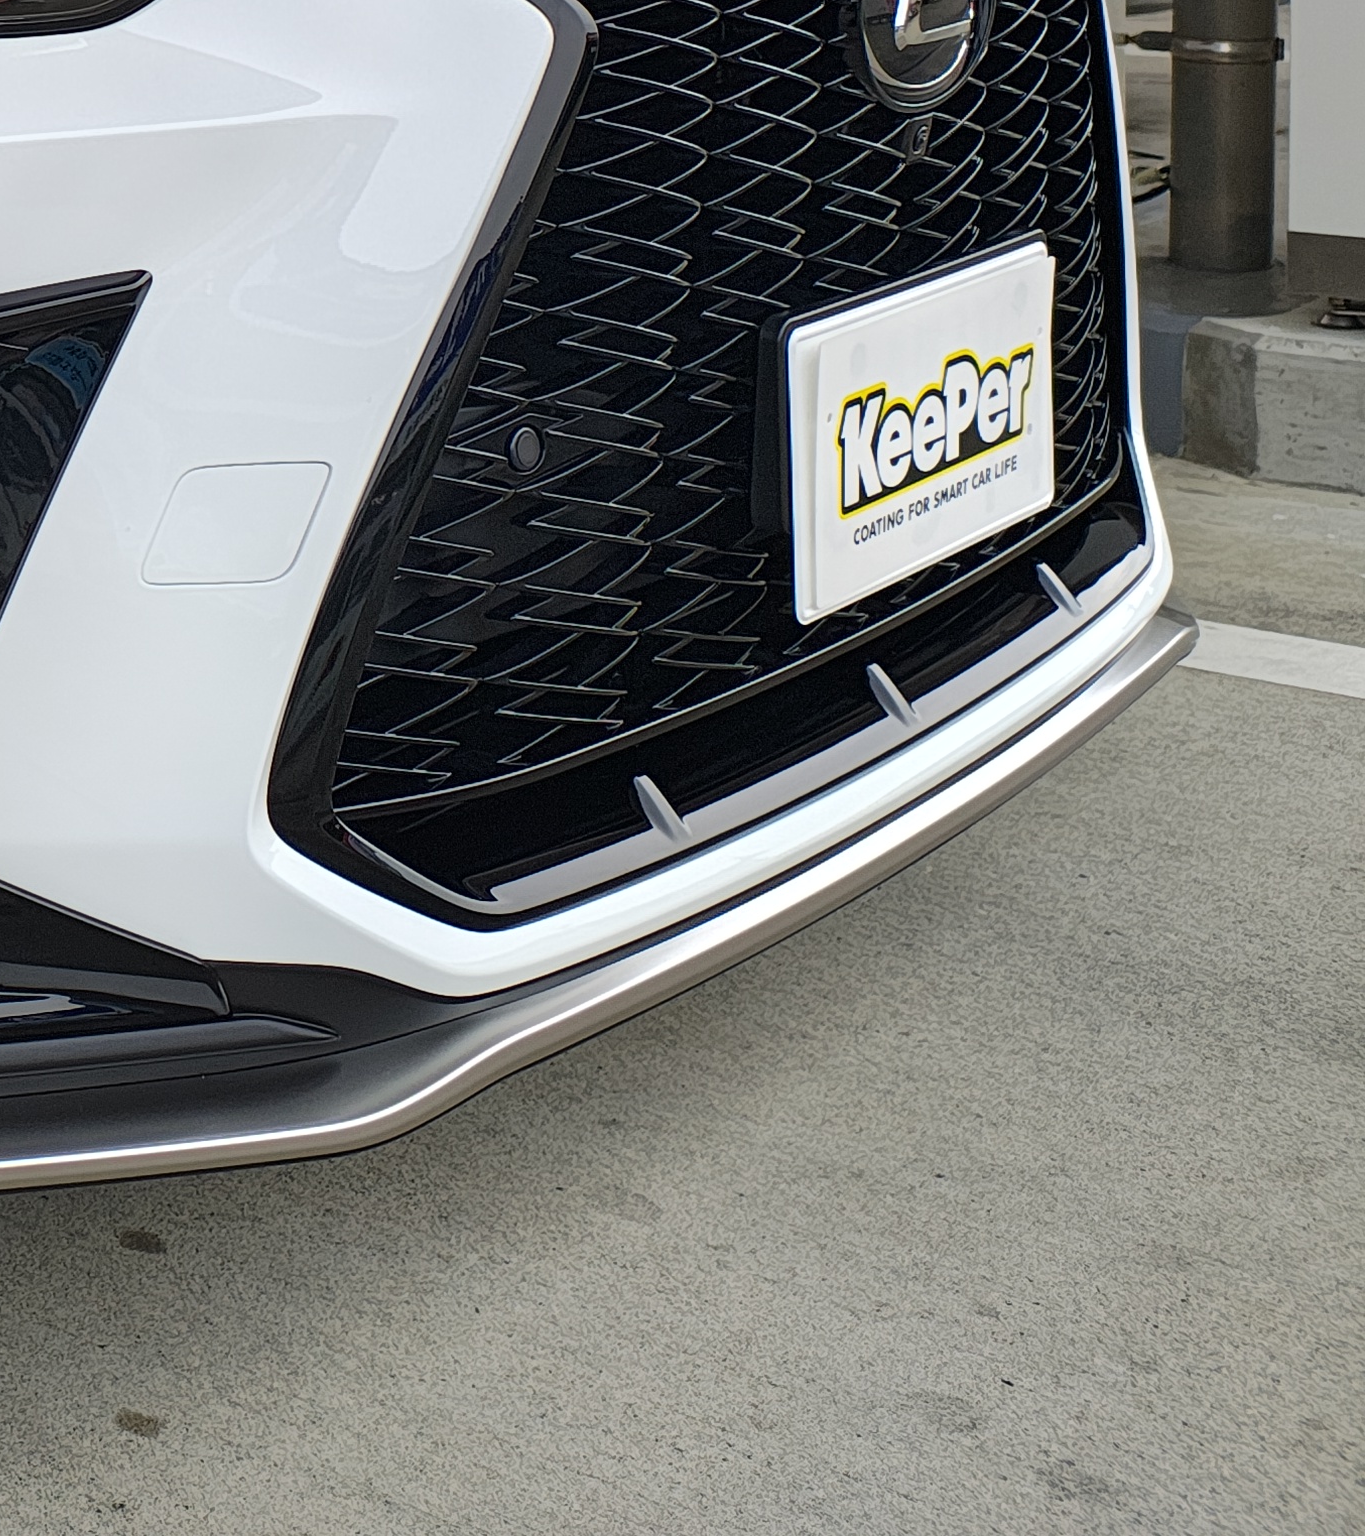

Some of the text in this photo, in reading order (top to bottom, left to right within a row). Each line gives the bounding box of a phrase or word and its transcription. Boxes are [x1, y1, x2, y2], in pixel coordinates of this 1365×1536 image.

[839, 348, 1034, 513] KeePer
[853, 454, 1018, 545] COATING FOR SMART CAR LIFE
